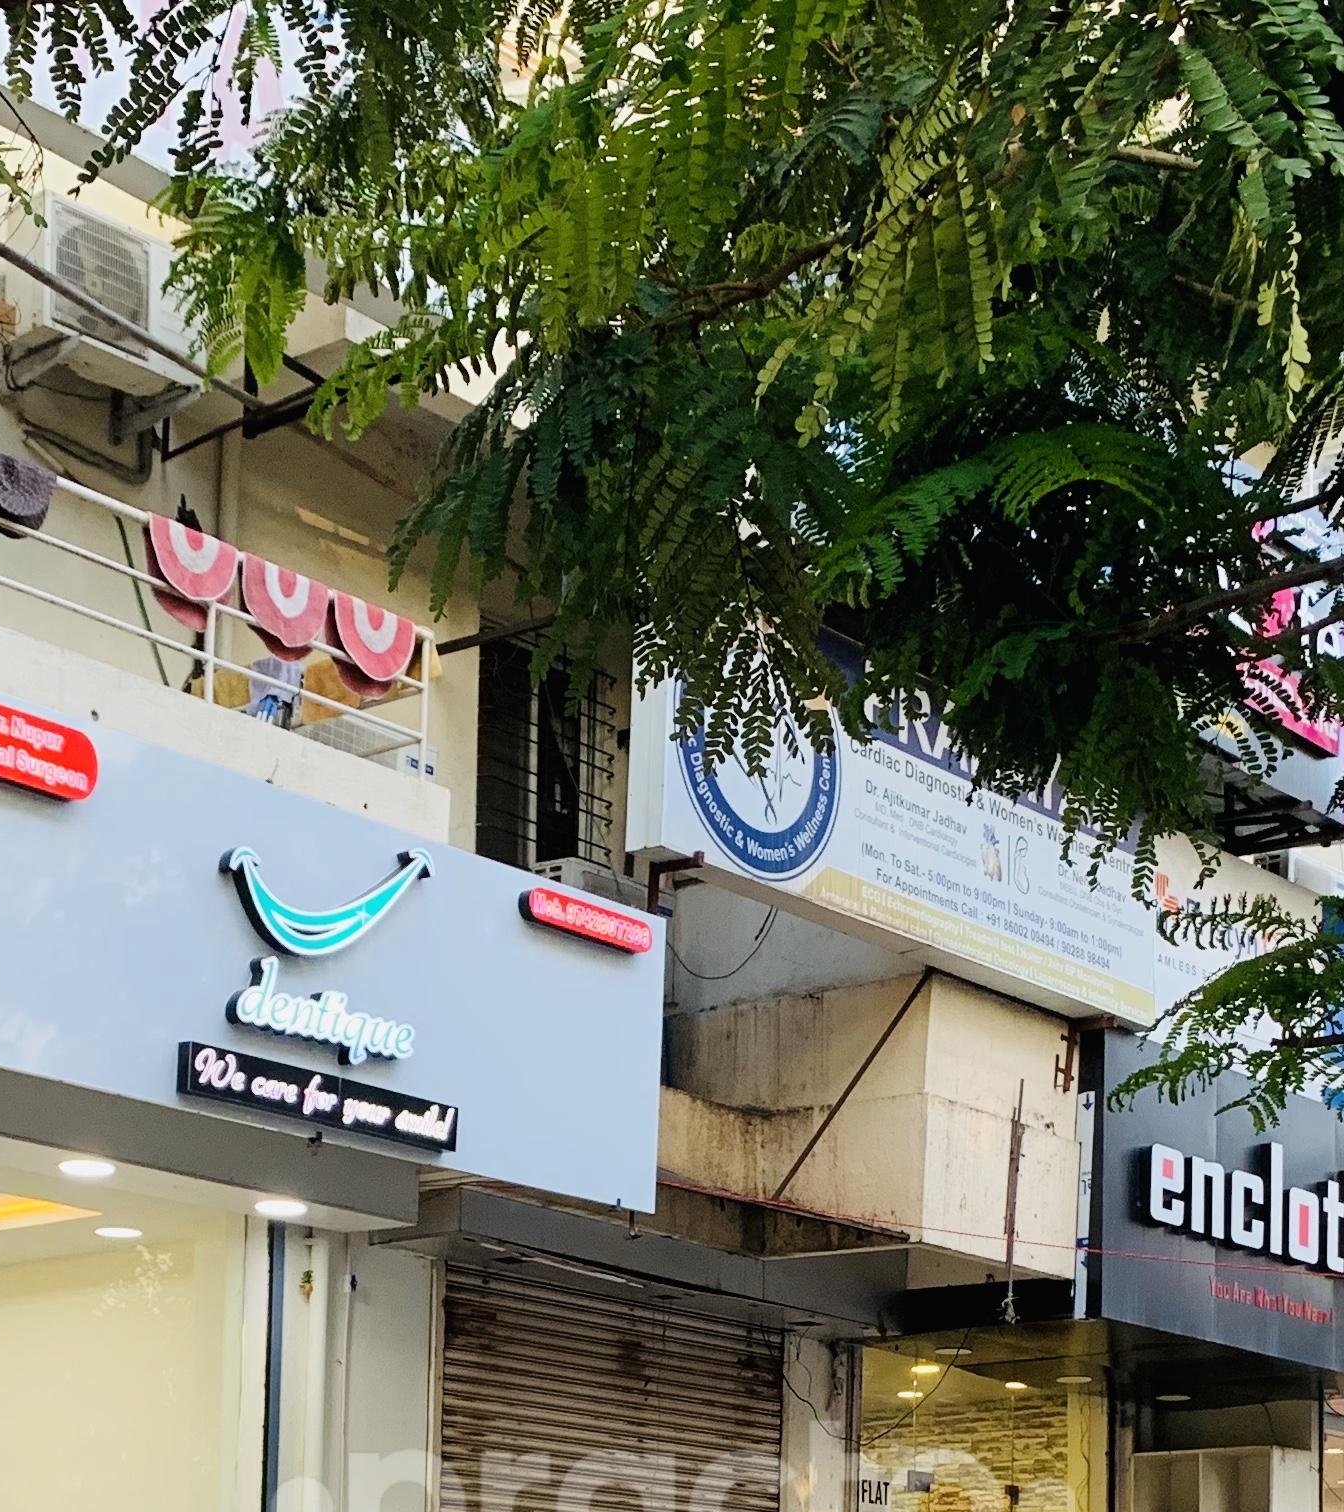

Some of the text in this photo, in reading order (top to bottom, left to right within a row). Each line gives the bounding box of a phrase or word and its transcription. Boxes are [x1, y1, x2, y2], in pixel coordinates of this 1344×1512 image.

[11, 715, 64, 752] Nupur
[16, 749, 88, 791] Surgeon
[690, 752, 735, 838] Diagnostic
[734, 830, 745, 850] &
[746, 837, 796, 862] Women's
[792, 793, 828, 851] Wellness
[865, 779, 879, 796] Dr.
[882, 788, 930, 819] Ajitkumar
[933, 809, 968, 835] Jadhav
[905, 760, 972, 803] Diagnosti
[976, 792, 985, 811] &
[988, 797, 1044, 837] Women's
[890, 852, 902, 869] To
[876, 868, 892, 884] For
[895, 876, 958, 912] Appointments
[961, 903, 978, 919] Call
[986, 912, 1001, 927] +91
[235, 956, 416, 1065] dentique
[194, 1048, 245, 1091] We
[251, 1076, 299, 1104] care
[302, 1074, 338, 1116] for
[341, 1097, 392, 1125] your
[1209, 1275, 1230, 1299] You
[1232, 1282, 1253, 1305] Are
[1281, 1291, 1304, 1317] You
[861, 1480, 890, 1506] FLAT
